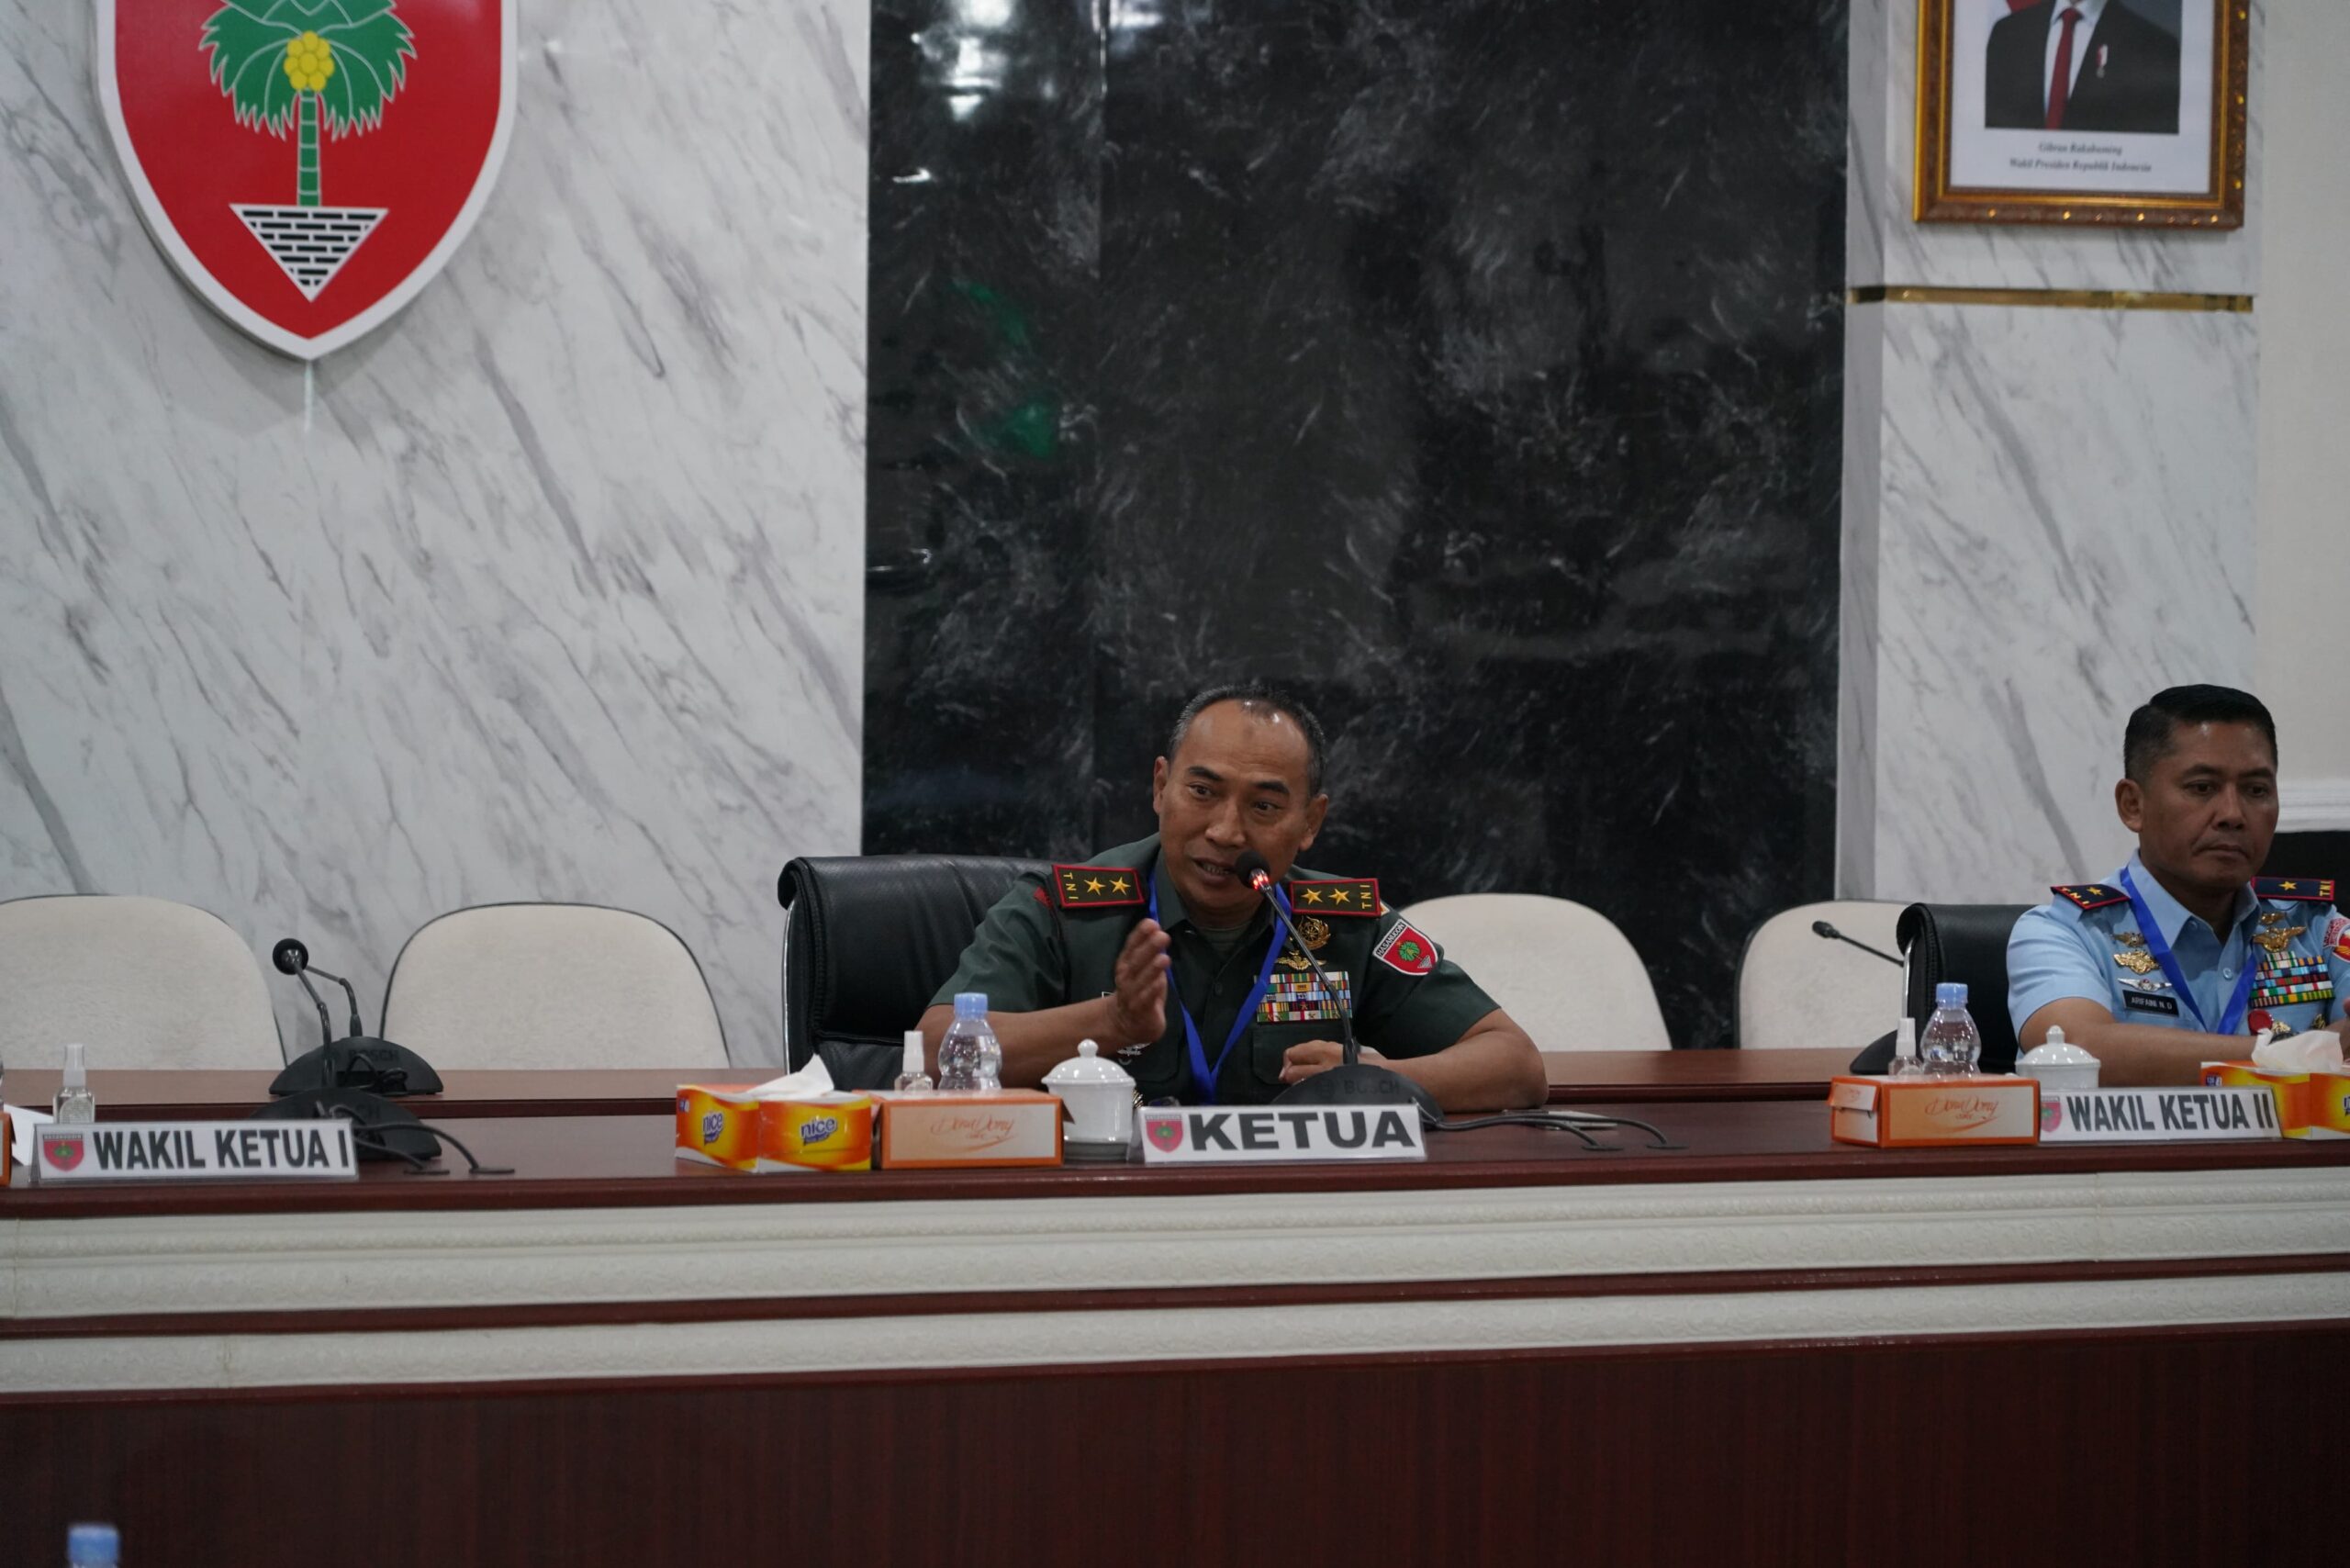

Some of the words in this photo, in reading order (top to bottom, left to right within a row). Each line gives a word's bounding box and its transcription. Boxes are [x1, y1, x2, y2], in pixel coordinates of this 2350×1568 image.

[1063, 872, 1079, 899] TNI
[1360, 884, 1371, 909] TNI
[703, 1112, 723, 1134] nice
[2066, 1095, 2156, 1132] WAKIL
[2158, 1093, 2251, 1130] KETUA
[2253, 1093, 2274, 1129] II
[801, 1118, 836, 1138] nice
[1189, 1111, 1416, 1151] KETUA
[93, 1130, 206, 1170] WAKIL
[214, 1129, 330, 1170] KETUA
[338, 1130, 350, 1168] I
